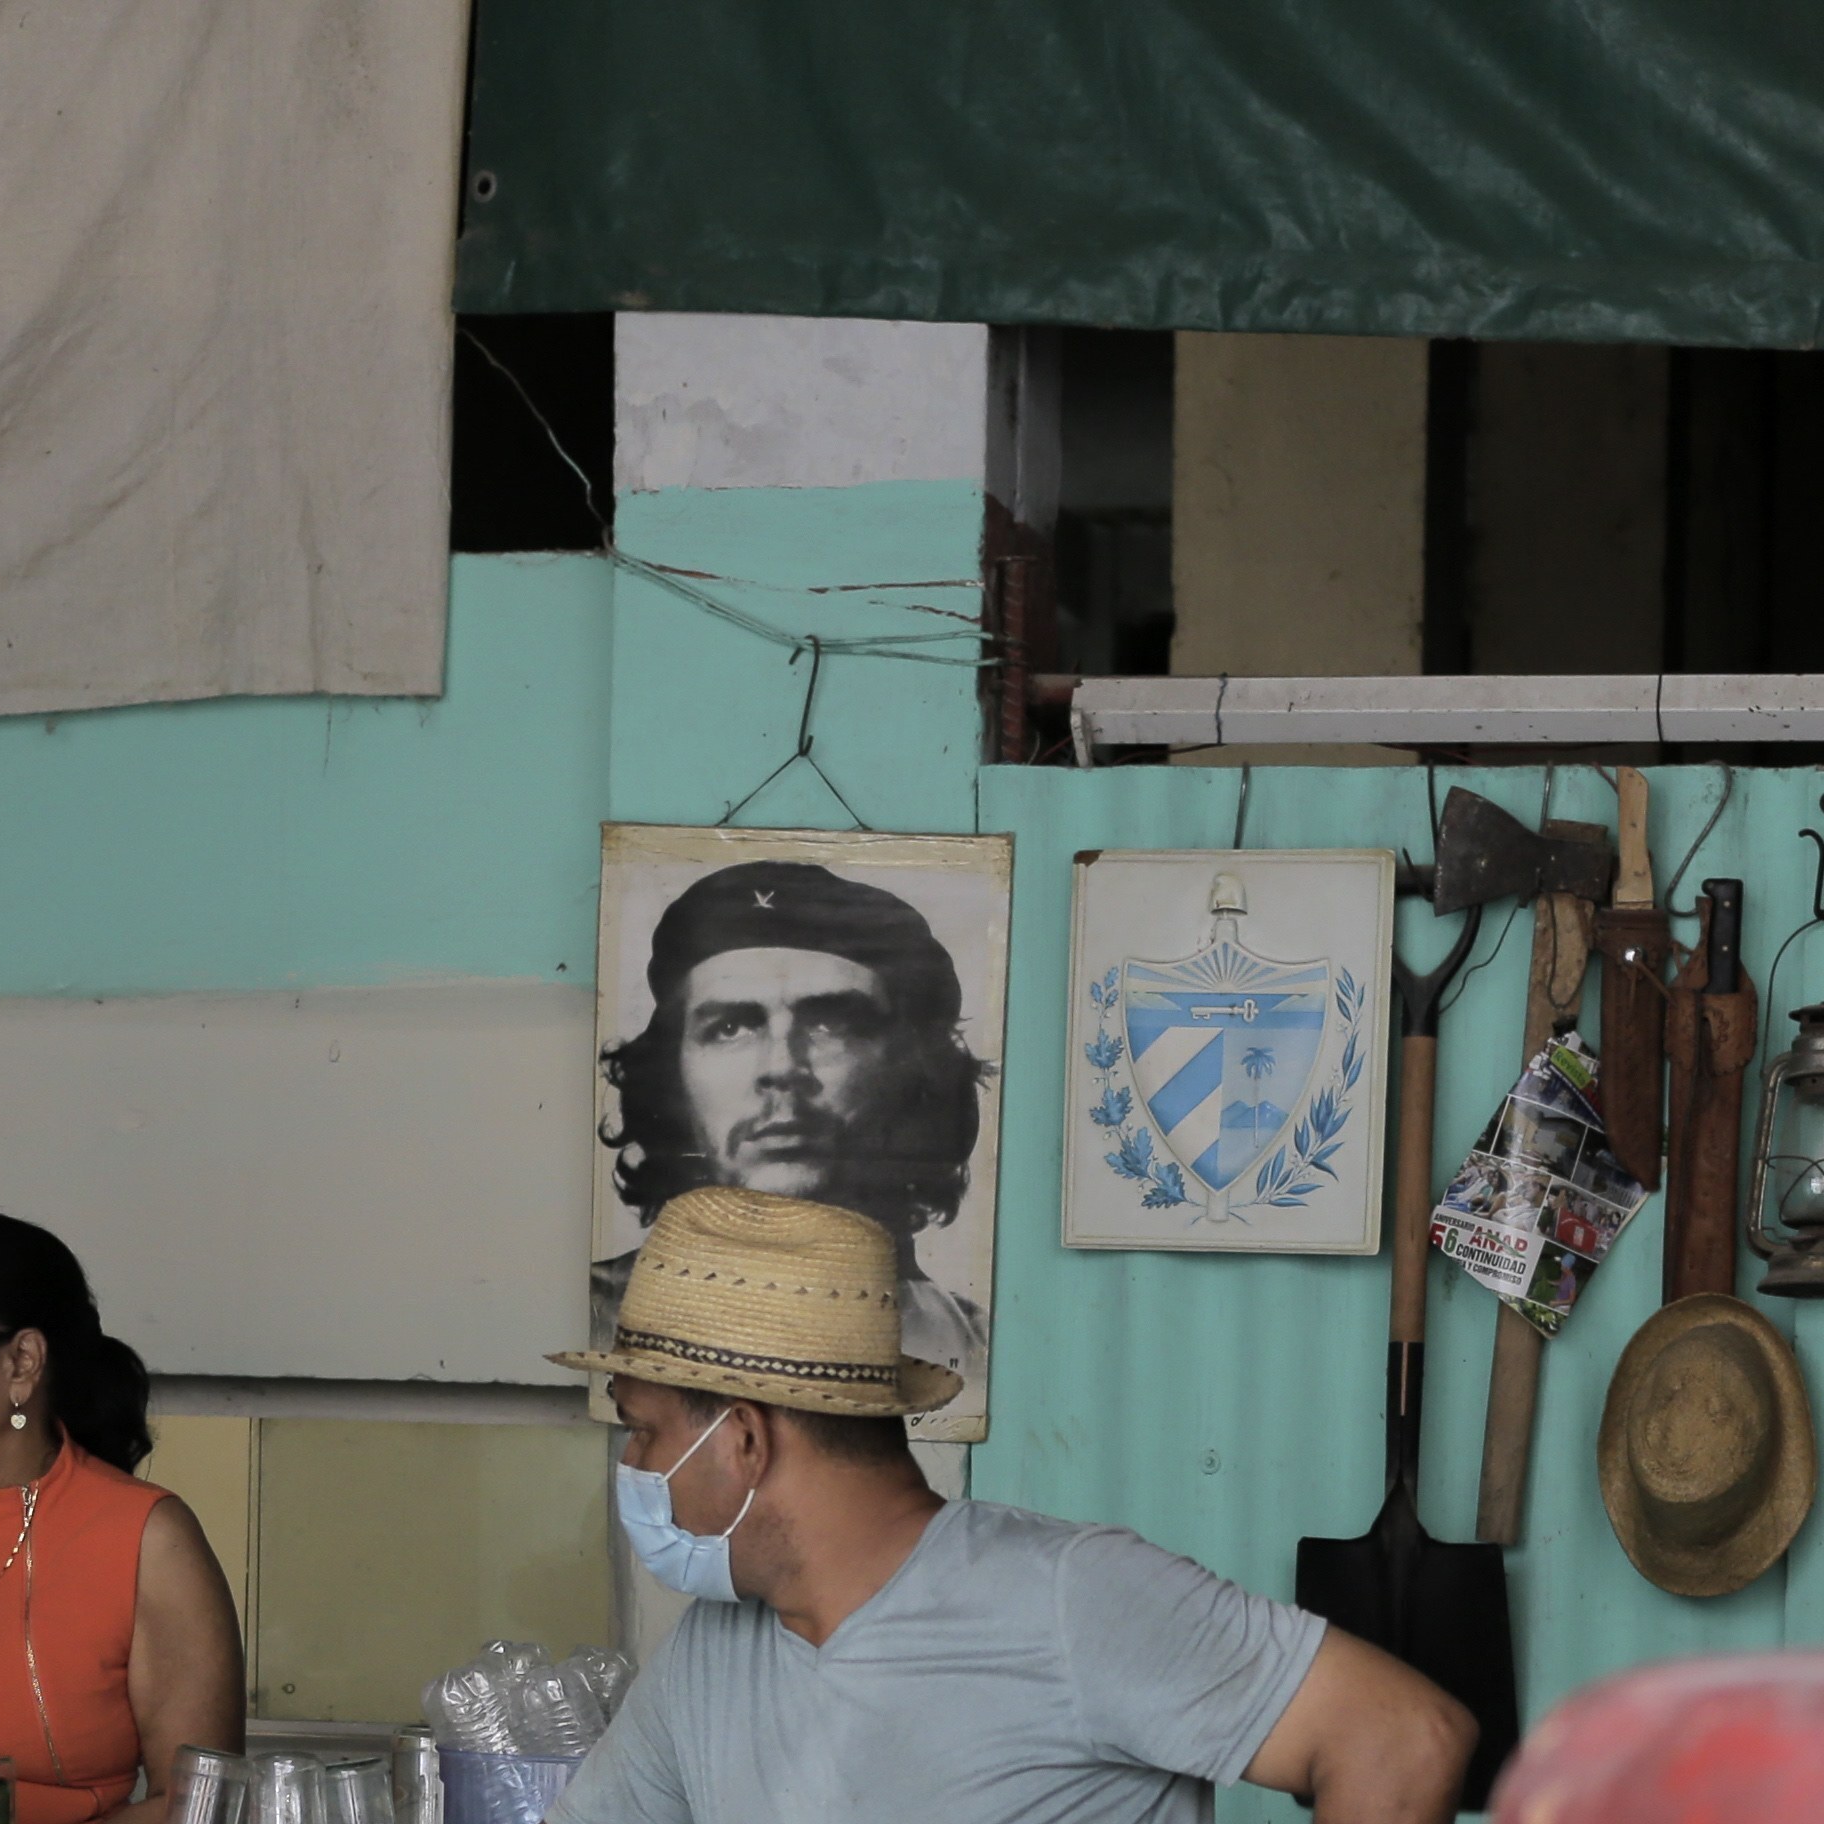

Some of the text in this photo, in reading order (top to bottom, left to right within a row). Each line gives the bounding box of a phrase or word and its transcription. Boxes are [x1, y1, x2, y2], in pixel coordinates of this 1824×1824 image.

[1434, 1213, 1476, 1232] ANIVERSARIO
[1430, 1222, 1459, 1253] 56
[1469, 1226, 1528, 1253] ANAP
[1456, 1243, 1527, 1275] CONTINUIDAD
[1472, 1263, 1522, 1285] COMPROMISO
